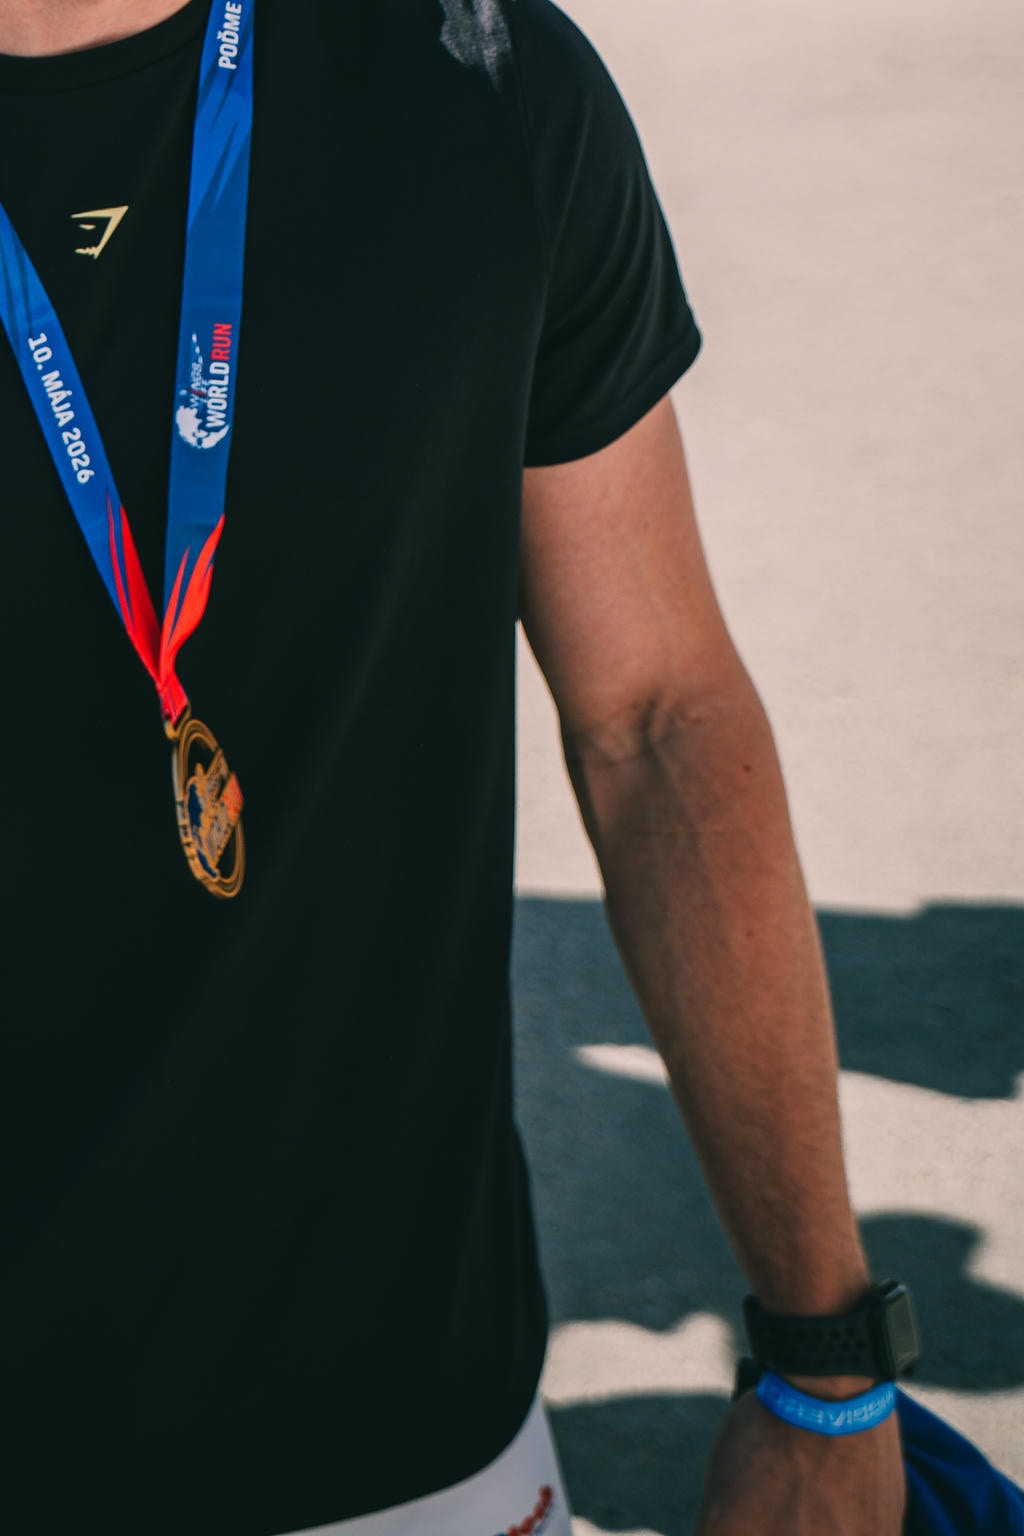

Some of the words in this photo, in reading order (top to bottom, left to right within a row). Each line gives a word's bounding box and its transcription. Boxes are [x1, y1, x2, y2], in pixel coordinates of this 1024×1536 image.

[217, 1, 242, 70] POĎME
[211, 323, 233, 361] RUN
[28, 332, 52, 372] 10.
[41, 370, 75, 427] MÁJA
[62, 427, 95, 484] 2026
[206, 362, 230, 428] WORLD
